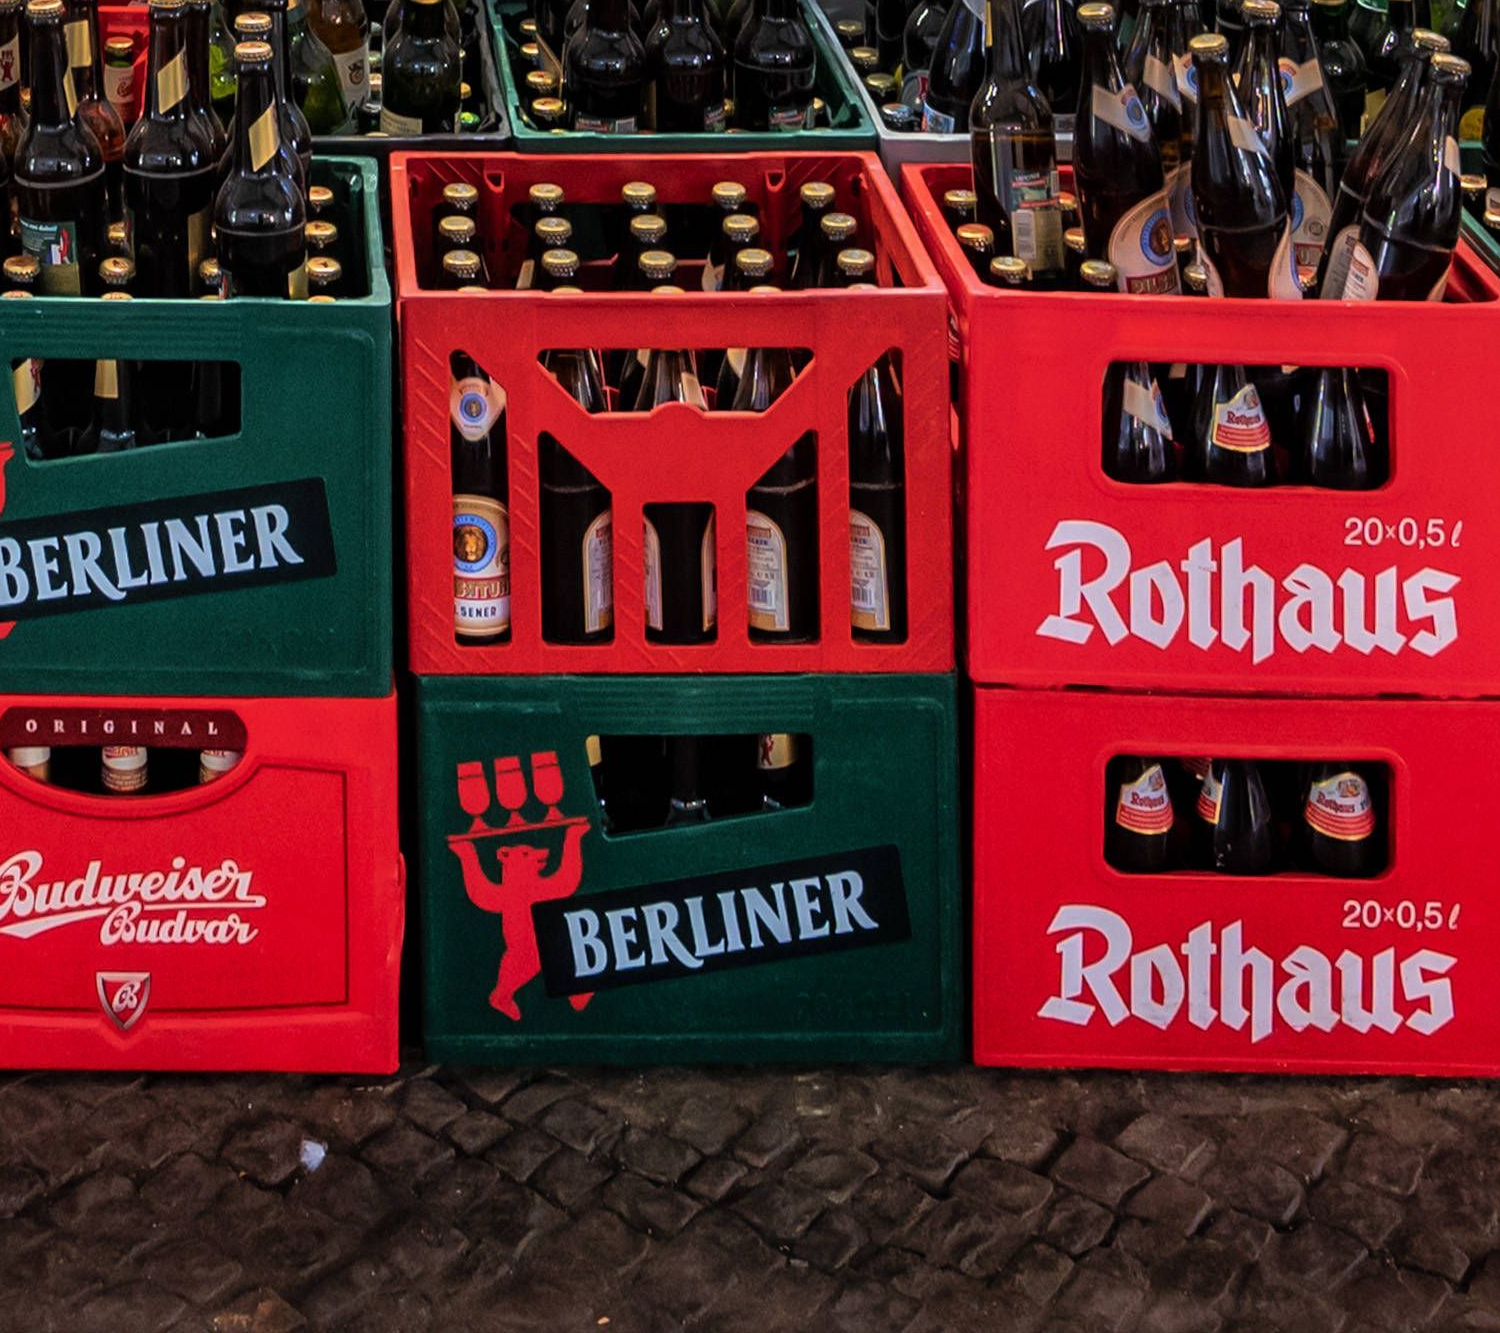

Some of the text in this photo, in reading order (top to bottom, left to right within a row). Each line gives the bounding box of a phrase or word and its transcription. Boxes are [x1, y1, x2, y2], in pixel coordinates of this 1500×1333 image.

[1036, 518, 1462, 668] Rothaus
[24, 718, 221, 735] ORIGINAL
[100, 899, 259, 946] Budvar
[562, 868, 880, 979] BERLINER
[1037, 903, 1457, 1043] Rothaus
